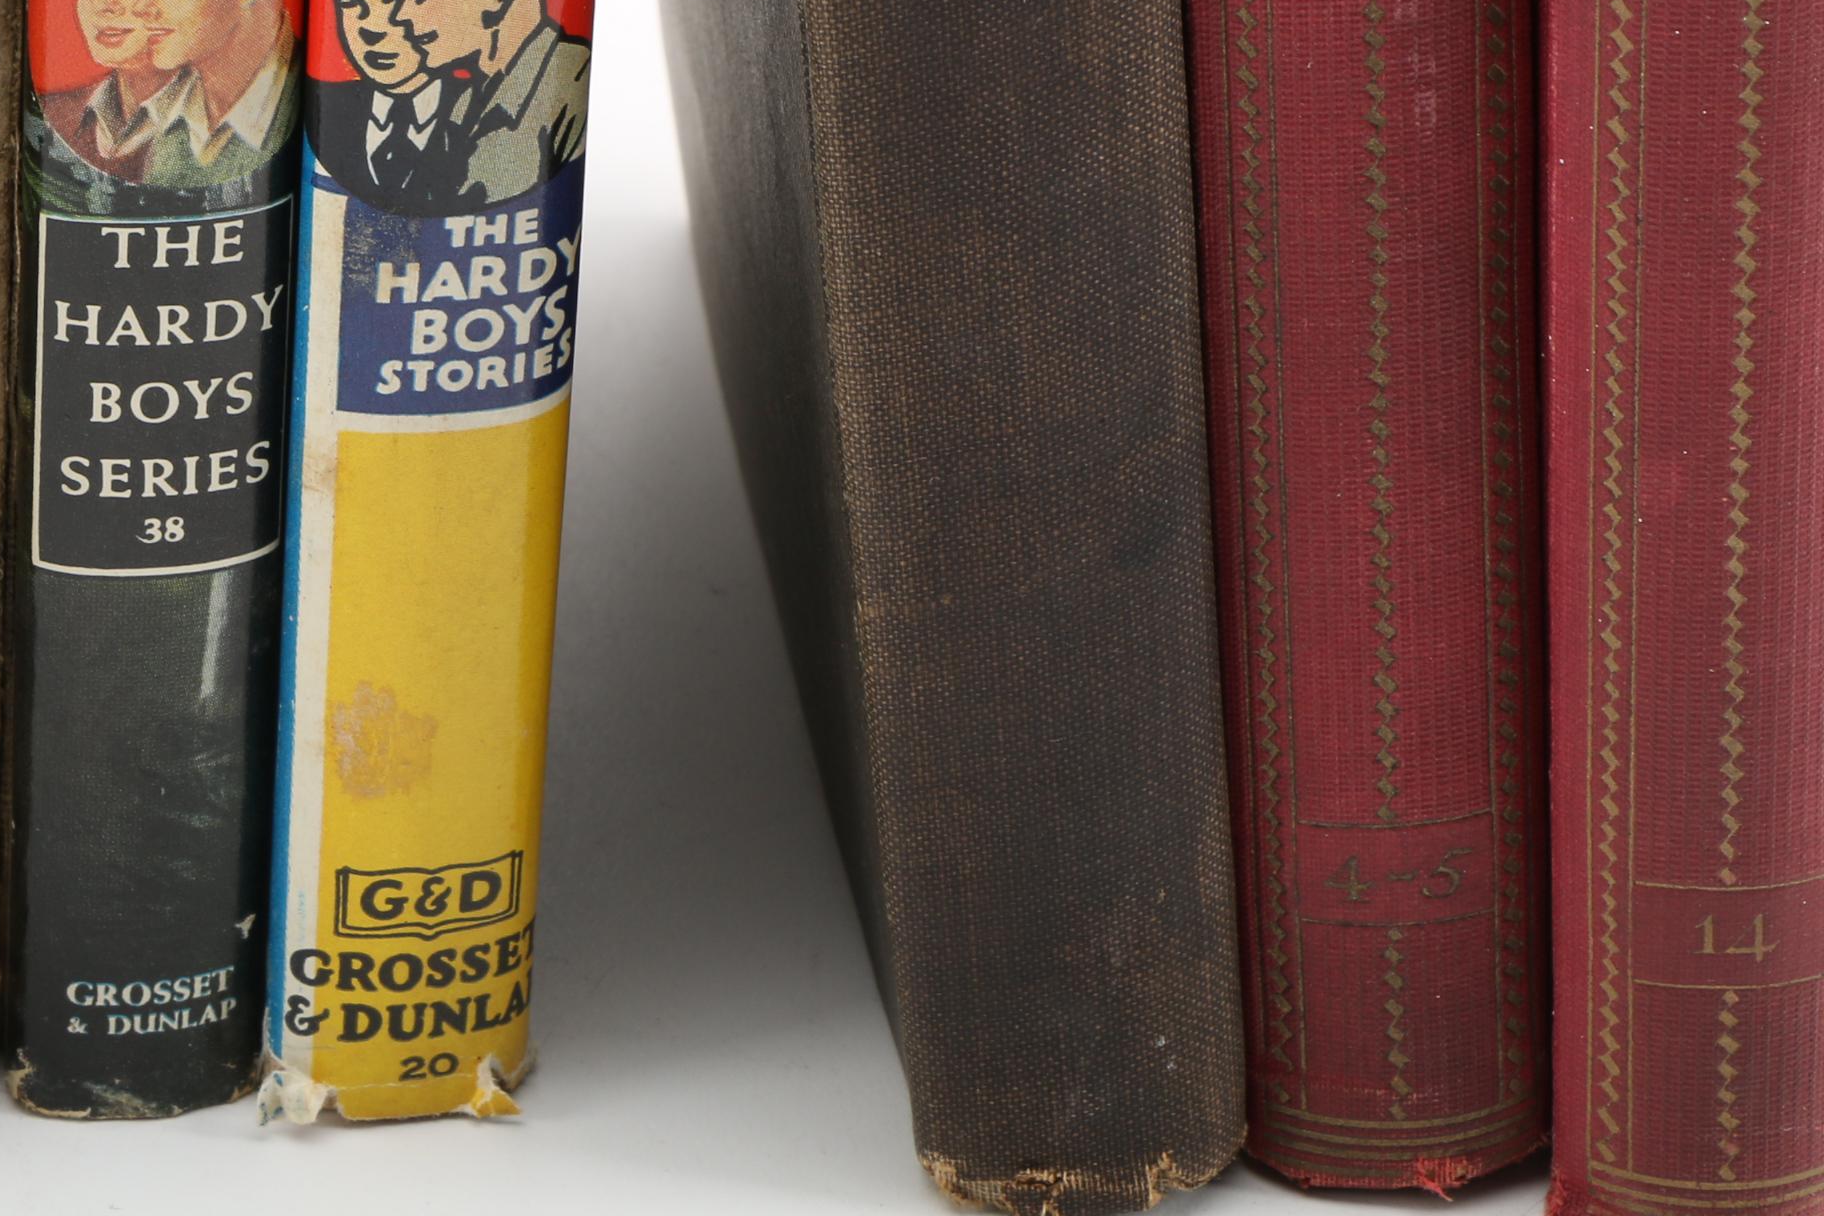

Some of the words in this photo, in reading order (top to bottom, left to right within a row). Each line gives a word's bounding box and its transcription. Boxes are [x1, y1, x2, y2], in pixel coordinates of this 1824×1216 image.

[101, 219, 244, 269] THE
[445, 208, 539, 248] THE
[376, 223, 582, 304] HARDY
[53, 284, 284, 346] HARDY
[411, 285, 568, 355] BOYS
[376, 327, 572, 395] STORIES
[89, 371, 254, 424] BOYS
[60, 441, 270, 499] SERIES
[136, 516, 185, 544] 38
[360, 870, 502, 921] G&D
[1693, 913, 1780, 963] 14
[66, 966, 235, 1007] GROSSET
[285, 994, 330, 1036] &
[337, 966, 532, 1042] DUNLA
[67, 1017, 88, 1034] &
[107, 997, 237, 1035] DUNLAP
[399, 1052, 459, 1081] 20
